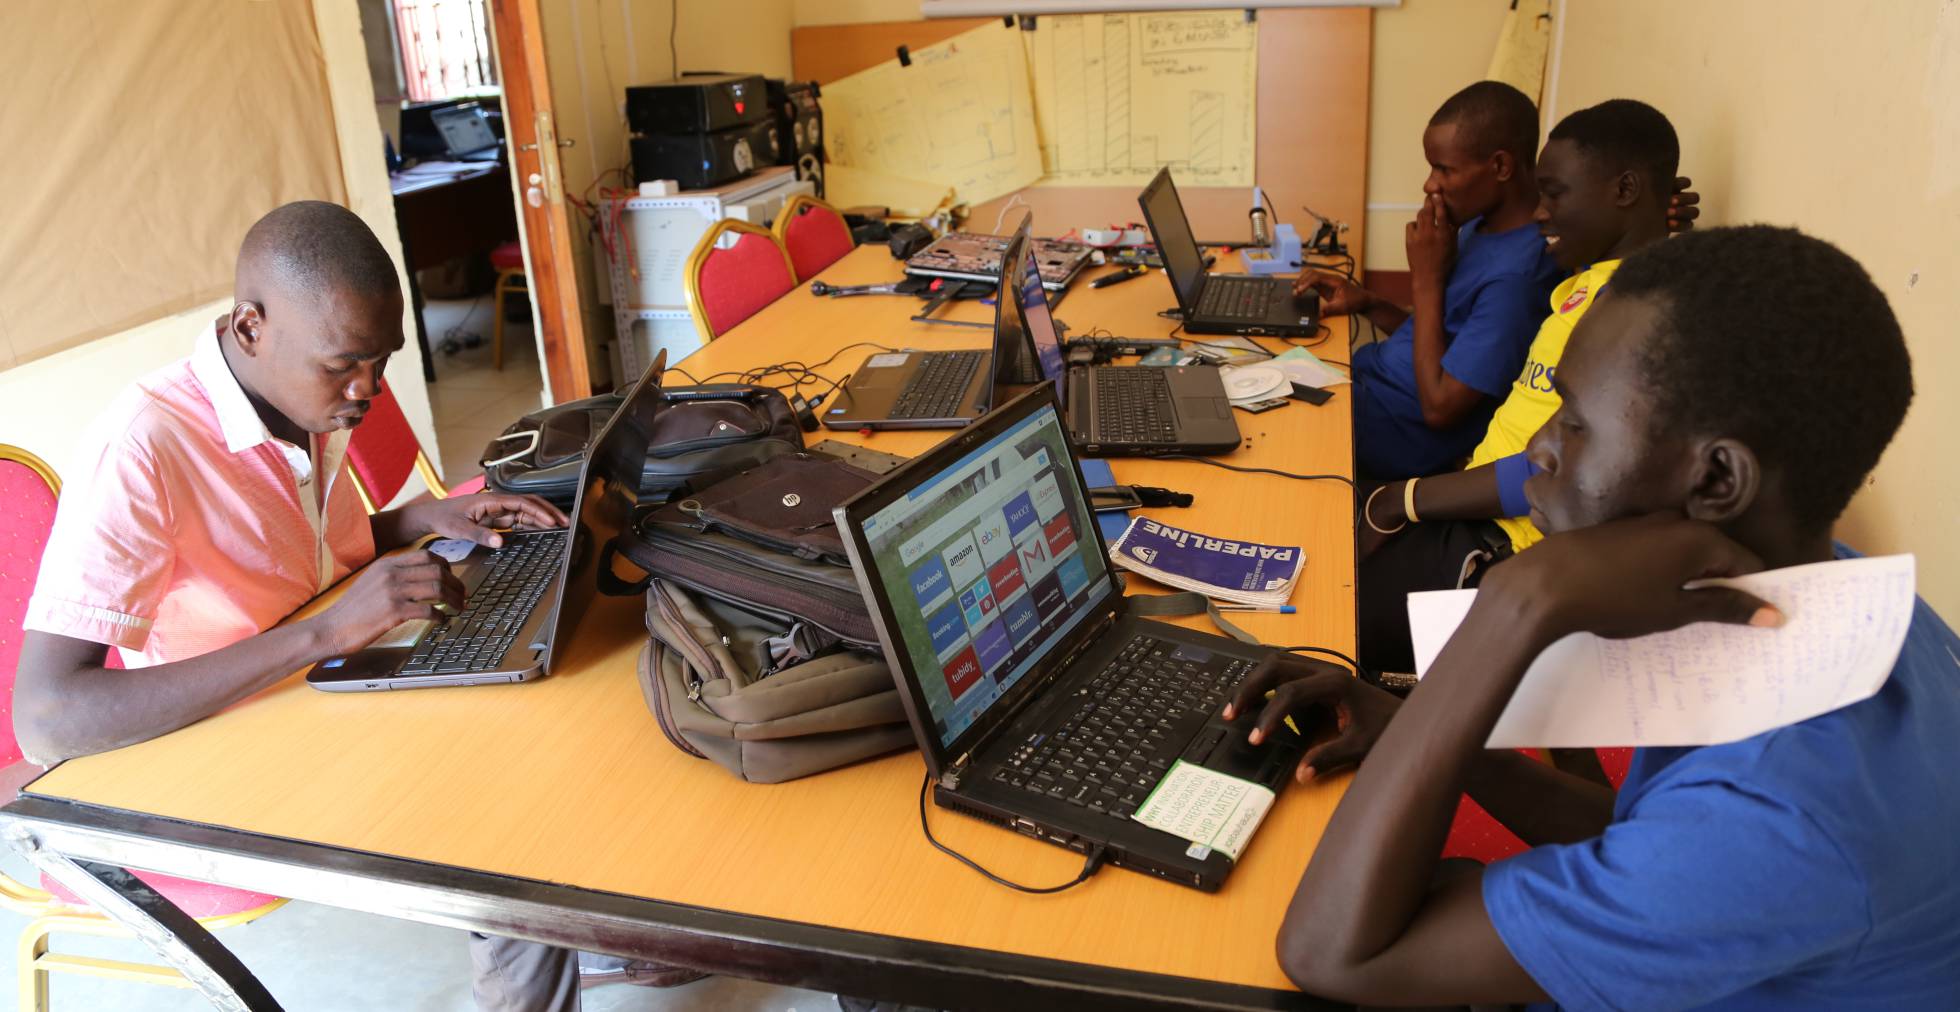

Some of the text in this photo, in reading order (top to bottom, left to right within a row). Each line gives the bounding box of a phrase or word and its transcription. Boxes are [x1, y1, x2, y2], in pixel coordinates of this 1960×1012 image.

[783, 494, 799, 506] hp
[981, 525, 1002, 545] ebay
[949, 544, 974, 567] amazon
[916, 569, 943, 594] facebook
[1144, 804, 1161, 822] WHY
[1193, 817, 1217, 840] SHIP
